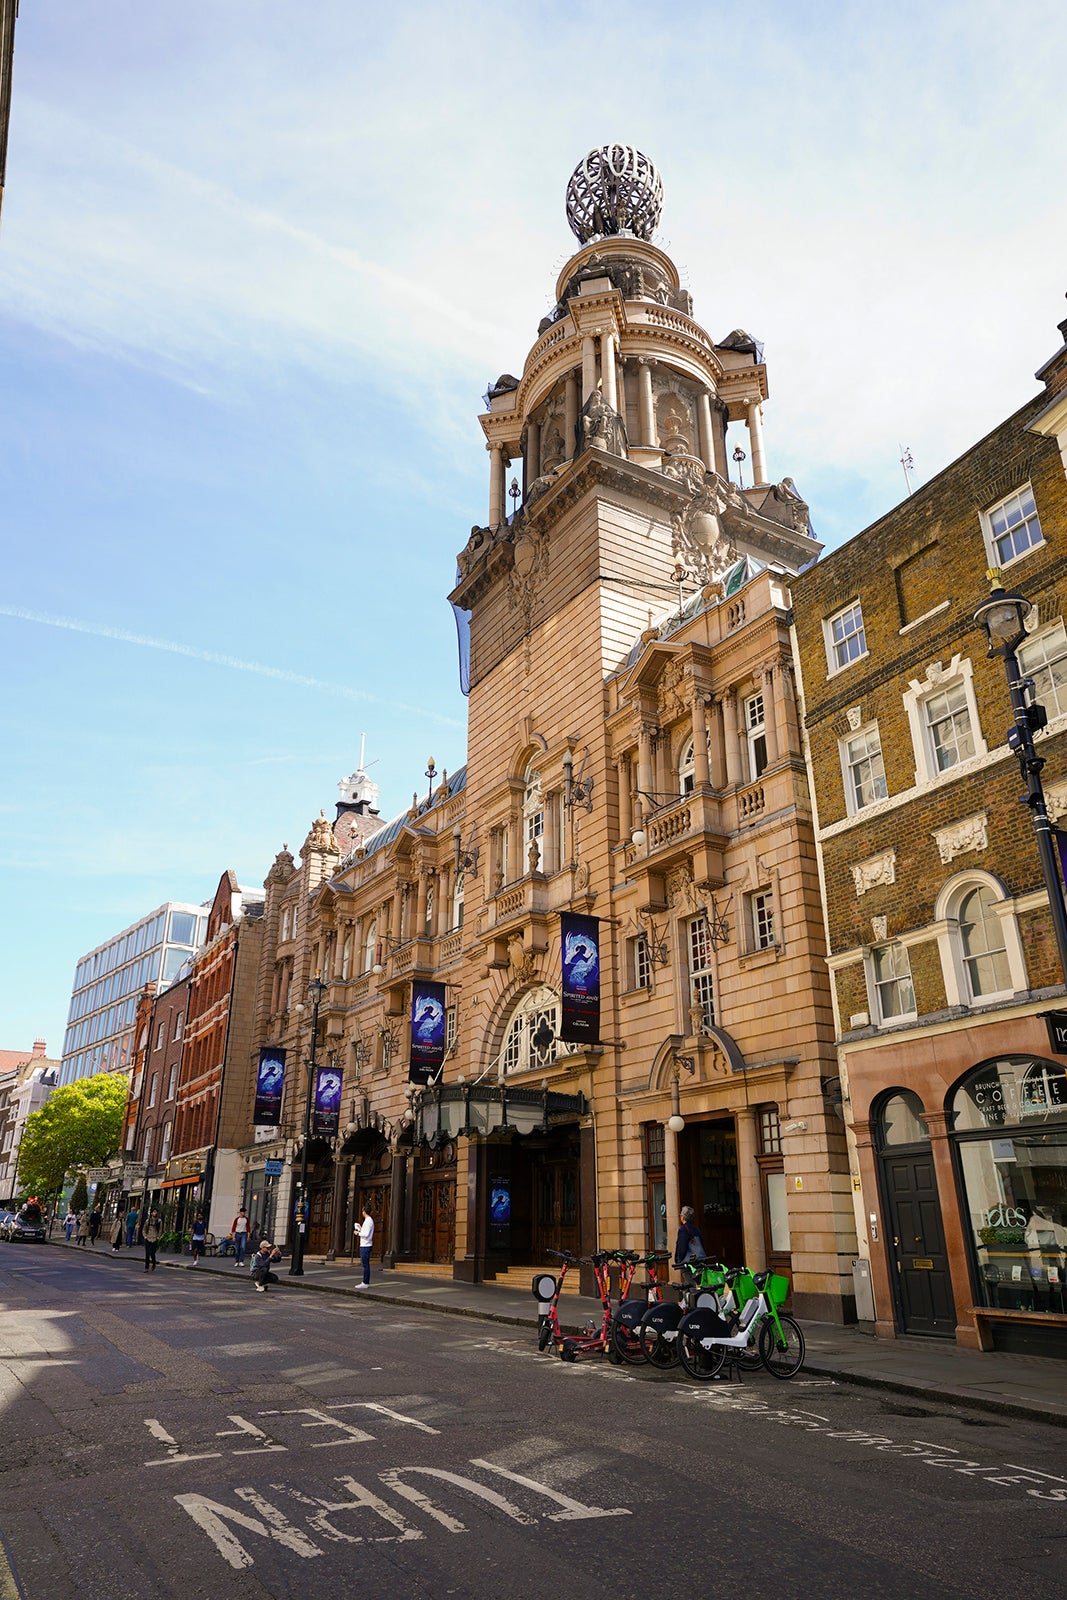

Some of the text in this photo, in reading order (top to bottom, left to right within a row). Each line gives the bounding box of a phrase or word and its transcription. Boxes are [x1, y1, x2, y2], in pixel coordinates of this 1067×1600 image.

[976, 1082, 1059, 1104] COFFEE
[980, 1203, 1027, 1227] notes
[142, 1401, 442, 1467] LEFT
[172, 1457, 633, 1570] TURN
